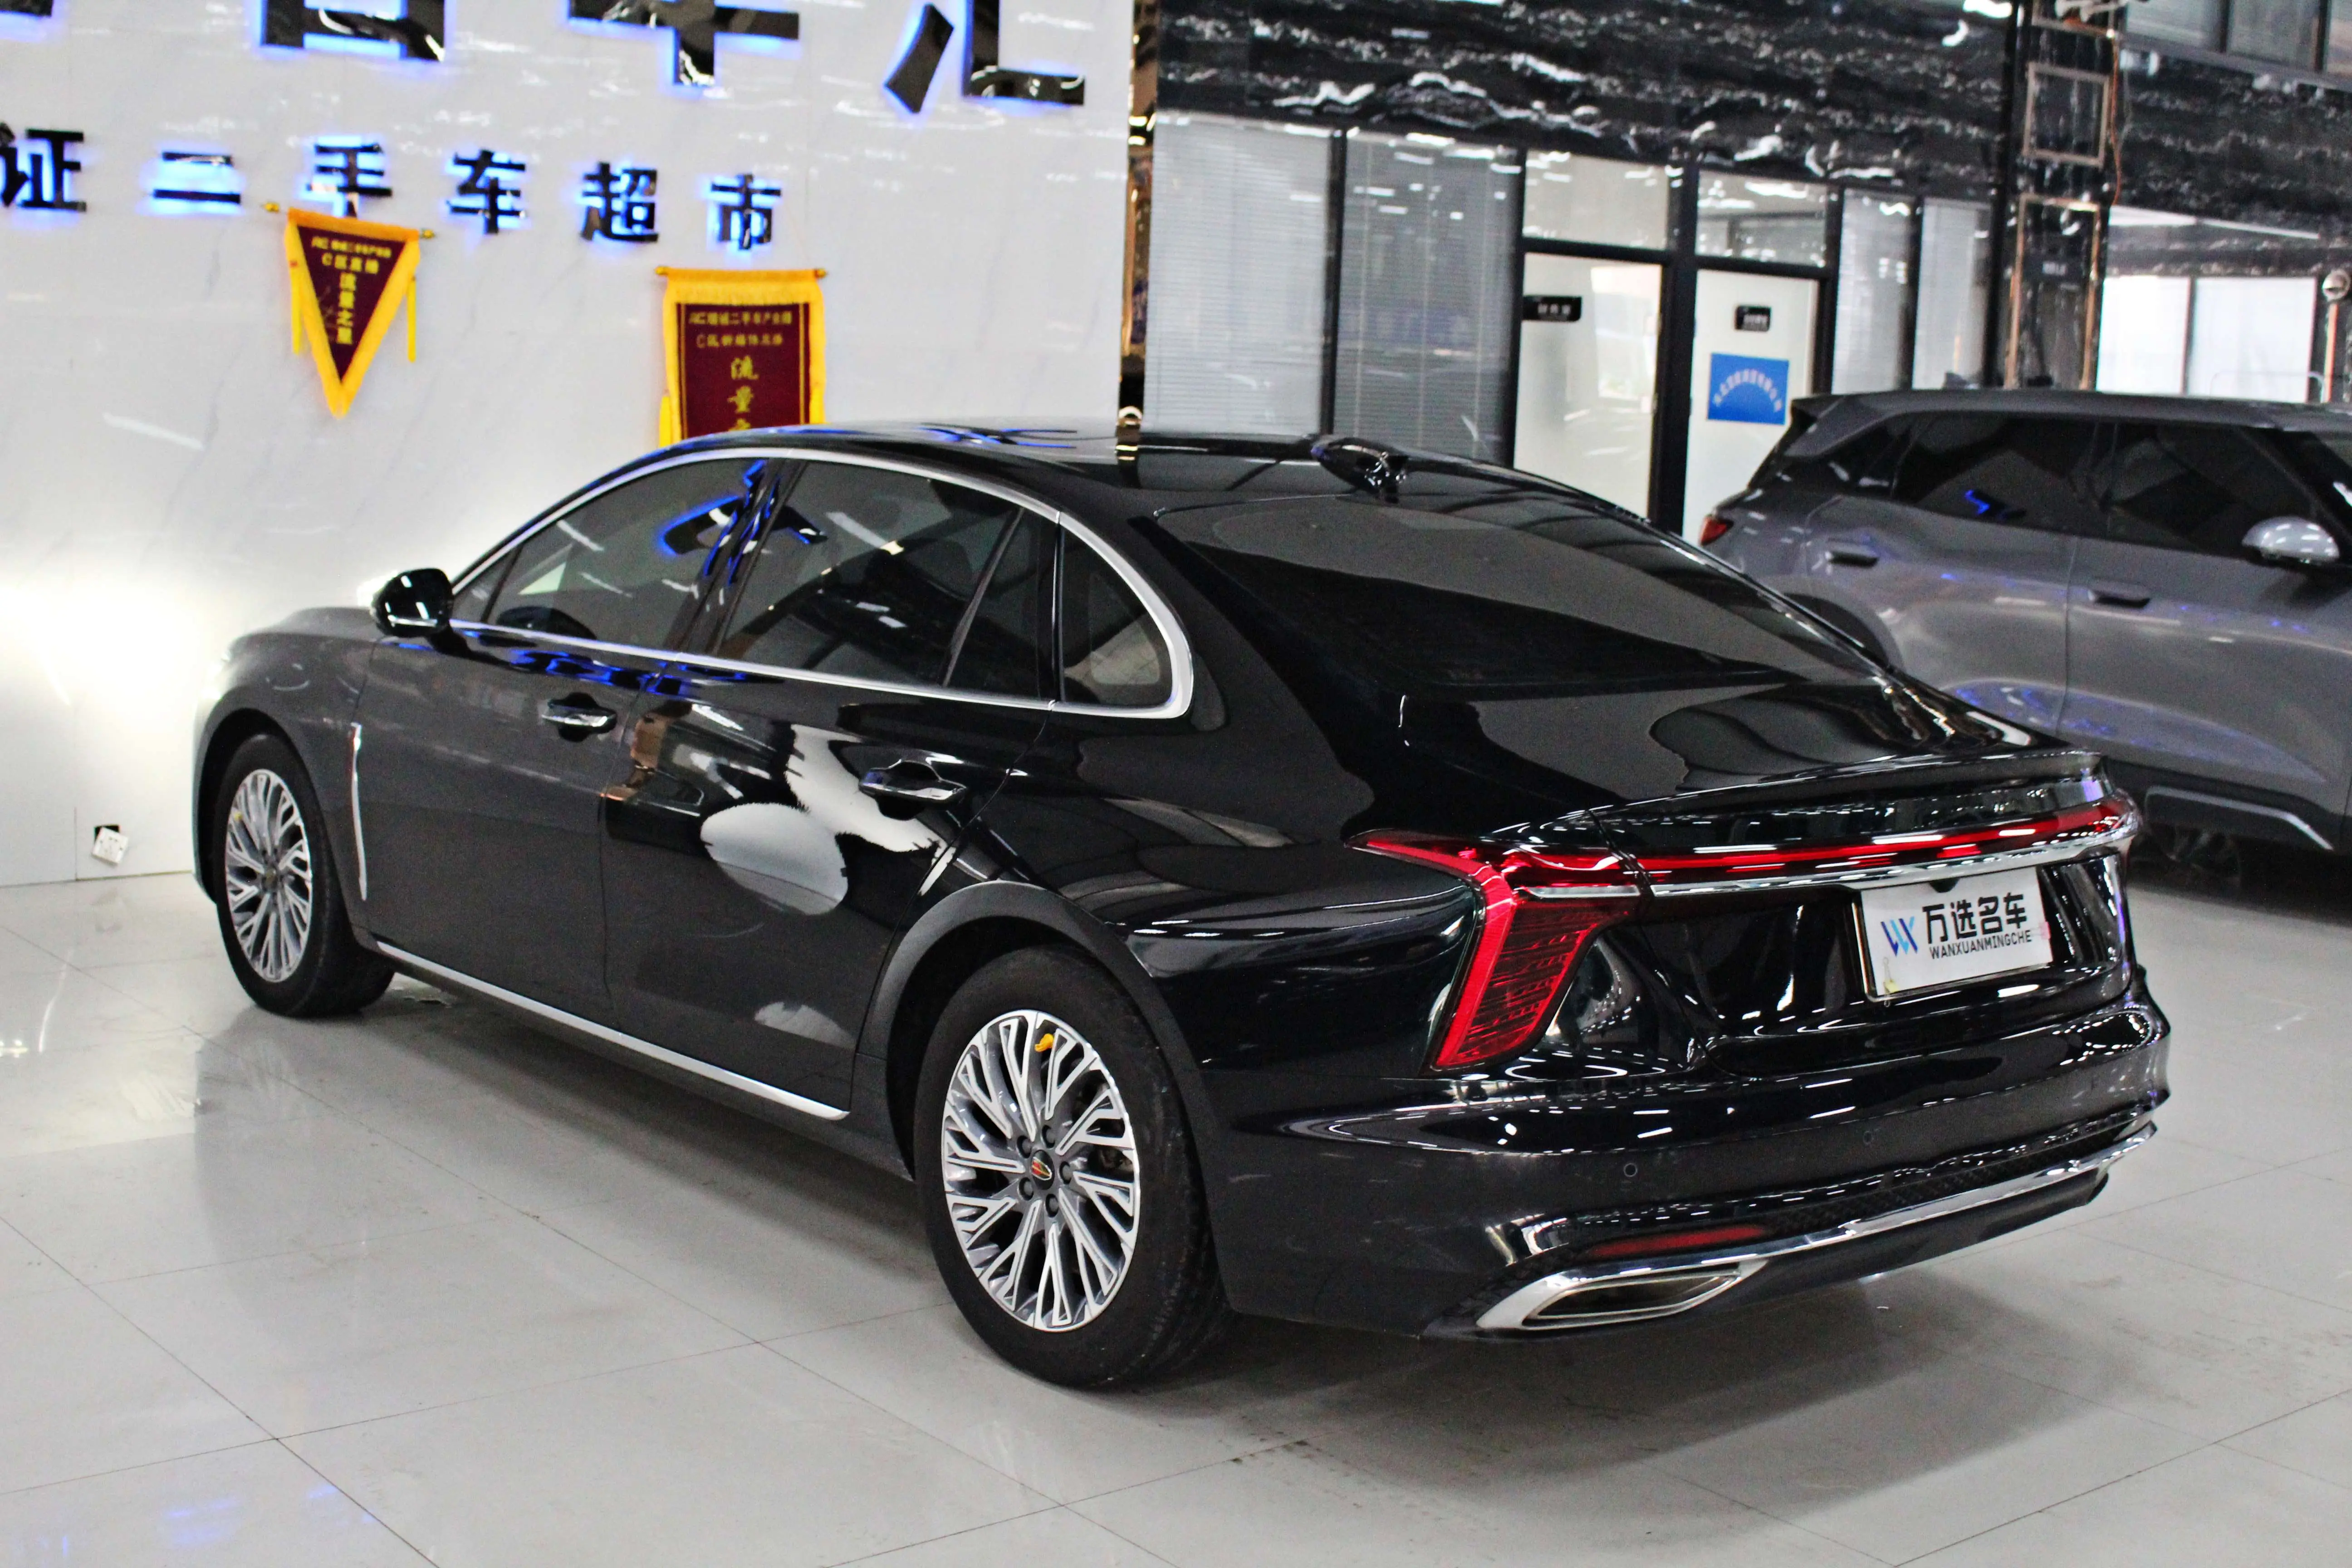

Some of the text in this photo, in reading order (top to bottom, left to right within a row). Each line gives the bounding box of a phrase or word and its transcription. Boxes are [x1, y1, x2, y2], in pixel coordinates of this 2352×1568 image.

[1922, 892, 2027, 944] 万选名车
[1929, 929, 2033, 960] WANXUANMINGCHE
